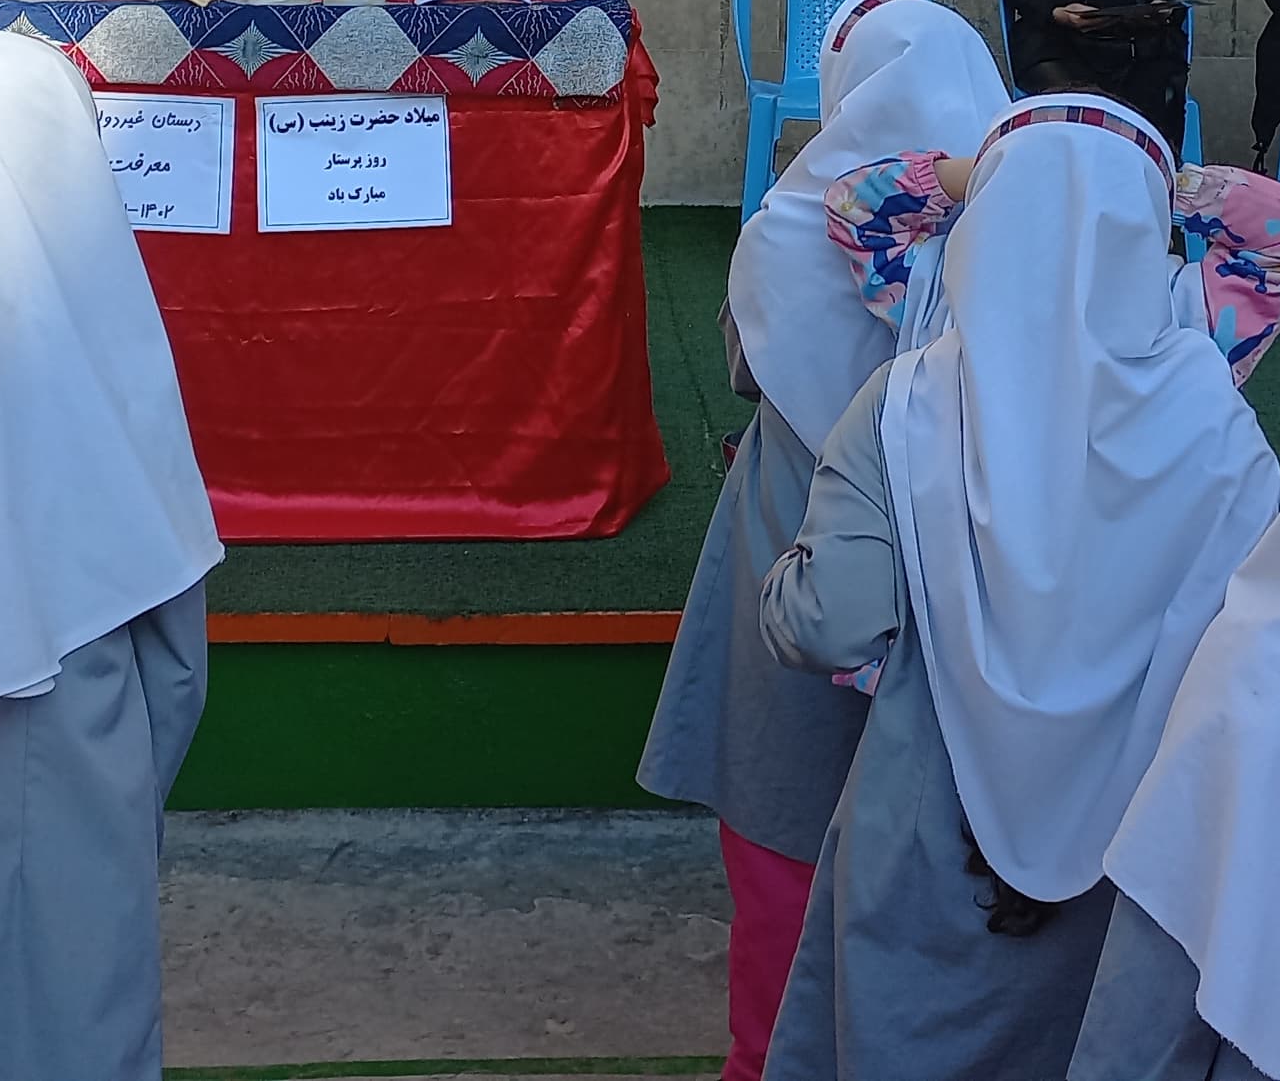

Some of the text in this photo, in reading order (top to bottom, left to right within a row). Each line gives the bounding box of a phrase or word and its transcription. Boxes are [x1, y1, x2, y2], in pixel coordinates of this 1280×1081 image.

[152, 112, 201, 133] دبستان
[269, 106, 440, 133] میلاد حضرت زینب (س)
[324, 153, 387, 170] روز پرستار
[328, 186, 386, 204] مبارک باد
